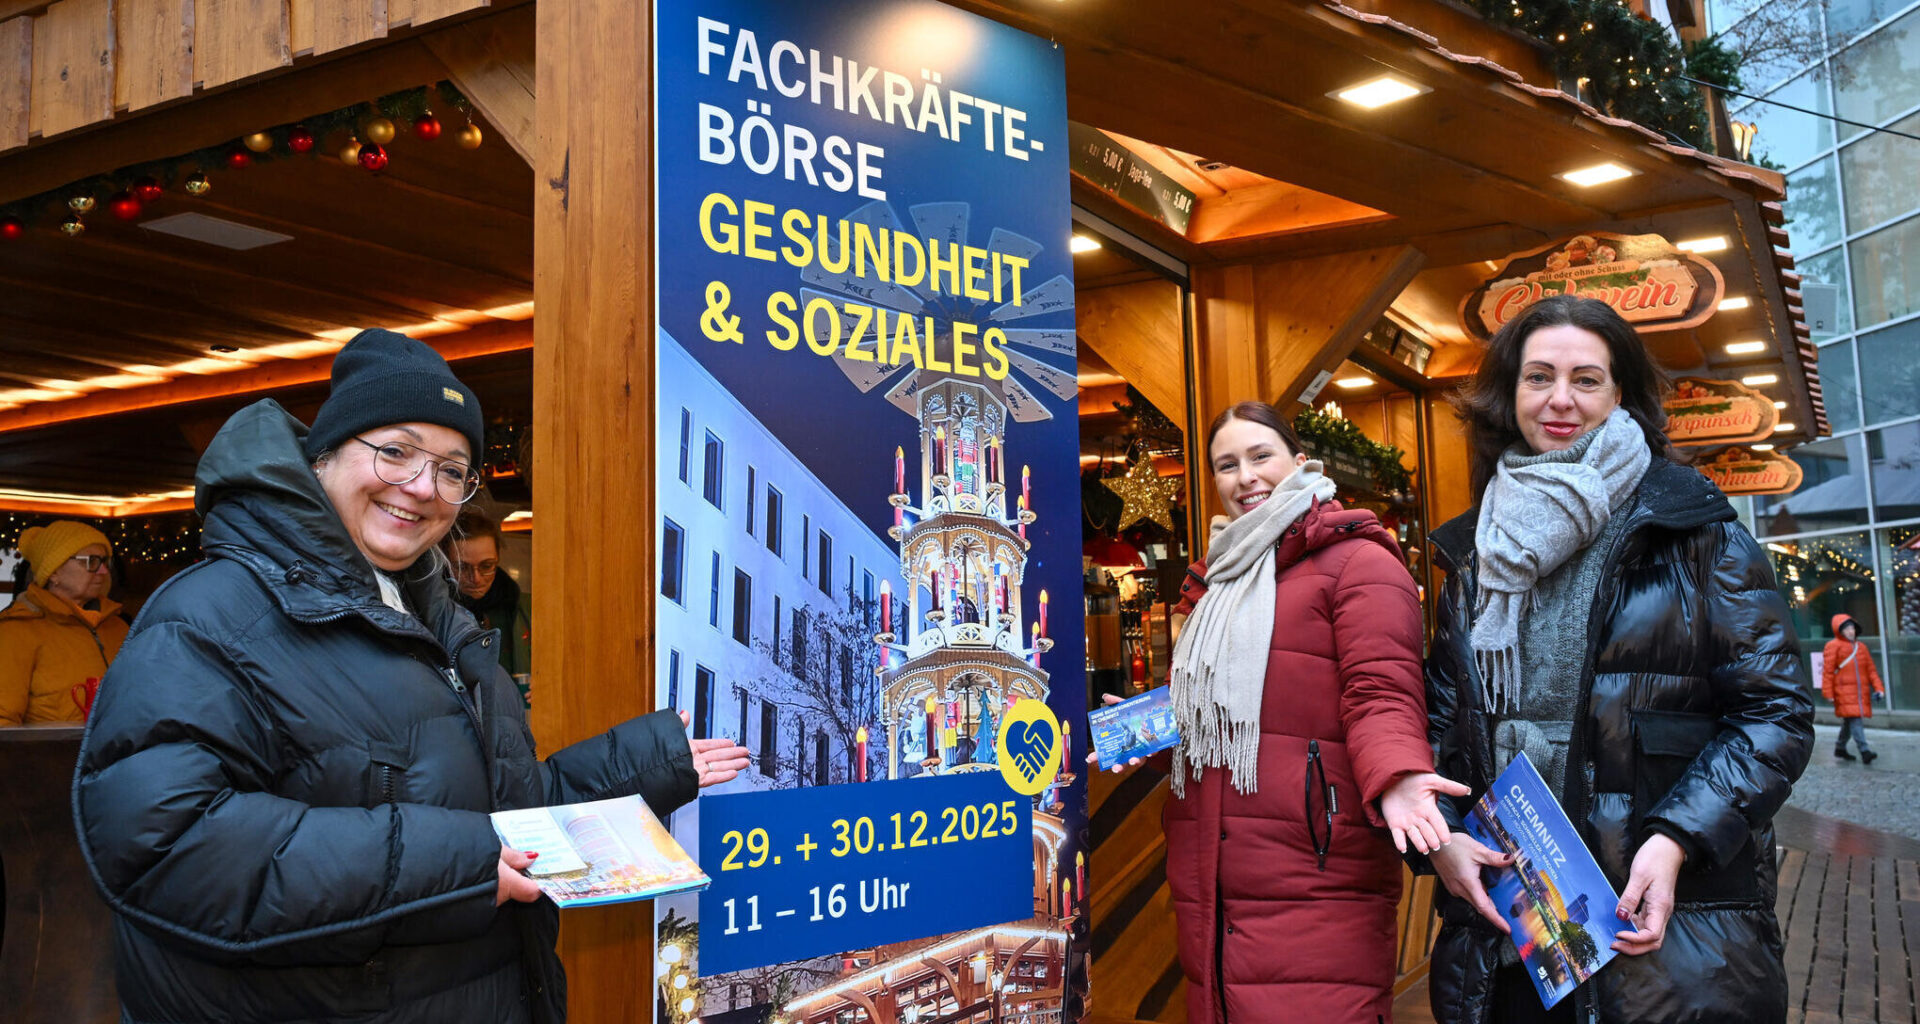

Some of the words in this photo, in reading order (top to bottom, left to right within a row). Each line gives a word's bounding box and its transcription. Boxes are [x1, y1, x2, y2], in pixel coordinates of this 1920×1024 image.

[698, 15, 1044, 161] FACHKRÄFTE-
[698, 99, 887, 201] BÖRSE
[699, 192, 1030, 307] GESUNDHEIT
[1538, 273, 1552, 281] mit
[1554, 271, 1572, 279] oder
[1574, 268, 1595, 277] ohne
[700, 280, 745, 346] &
[765, 290, 1010, 381] SOZIALES
[1495, 278, 1678, 325] Glwein
[720, 827, 782, 872] 29.
[796, 833, 818, 861] +
[830, 800, 1018, 857] 30.12.2025
[1510, 784, 1567, 869] CHEMNITZ
[723, 894, 762, 936] 11
[809, 883, 847, 923] 16
[859, 877, 910, 913] Uhr
